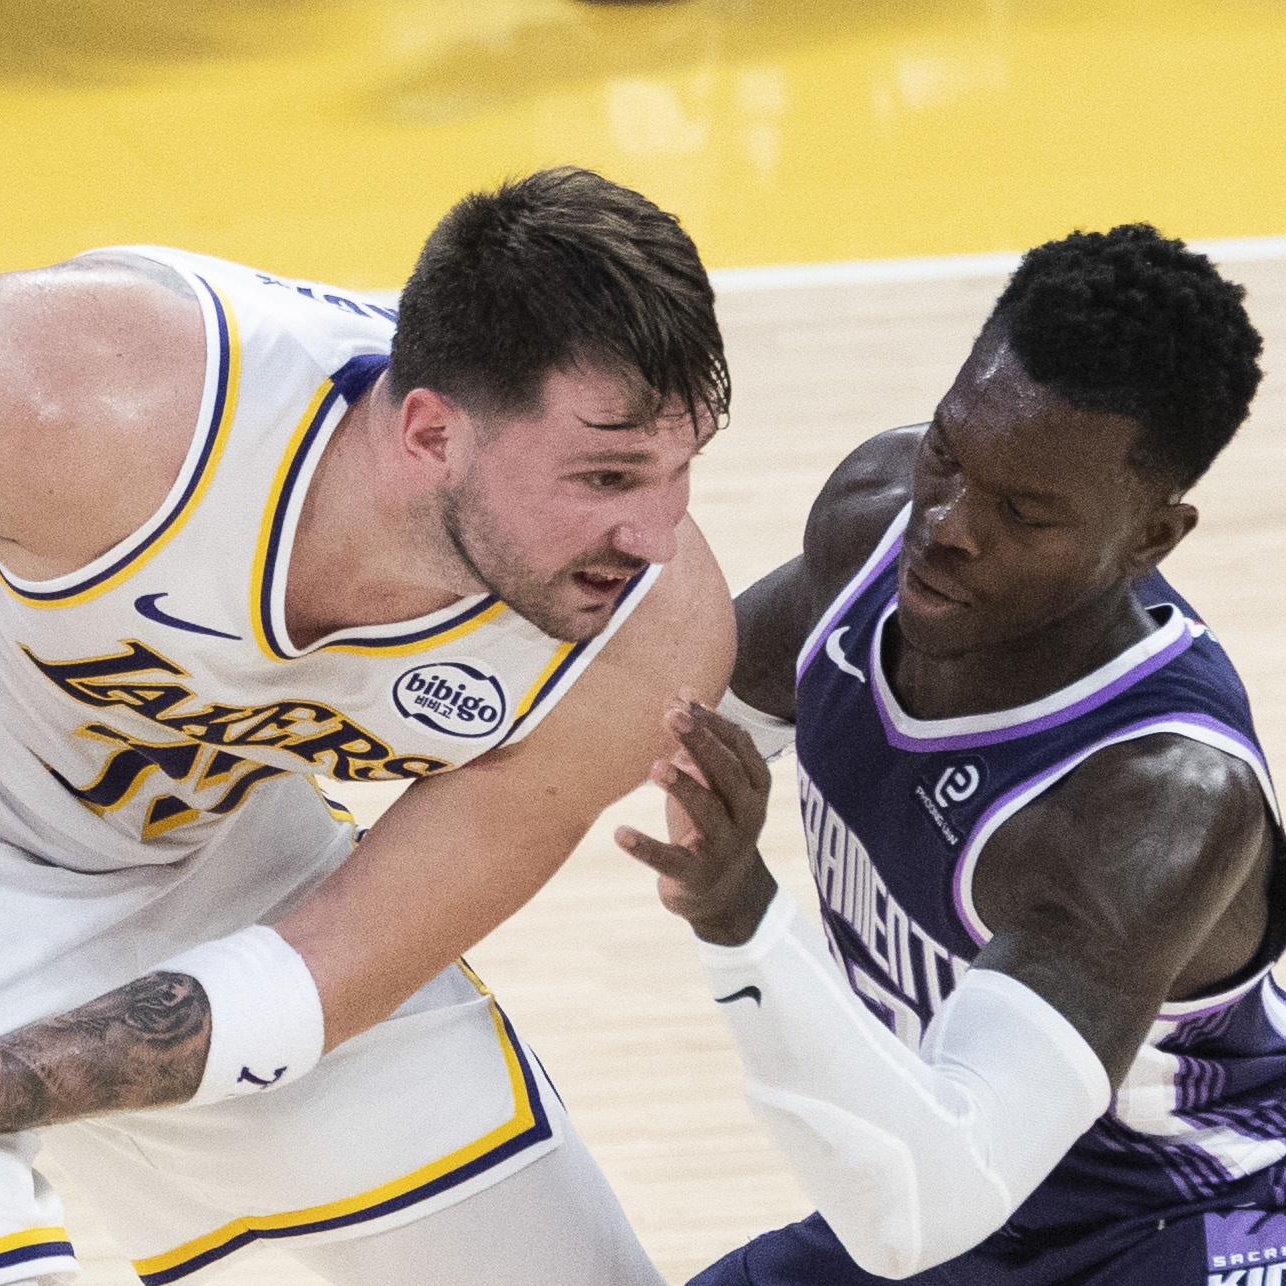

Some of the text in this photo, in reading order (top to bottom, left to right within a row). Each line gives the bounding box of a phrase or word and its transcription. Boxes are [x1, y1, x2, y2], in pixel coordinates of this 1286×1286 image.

[16, 638, 454, 782] LAKERS
[405, 672, 498, 722] bibigo
[414, 695, 453, 719] 비비고
